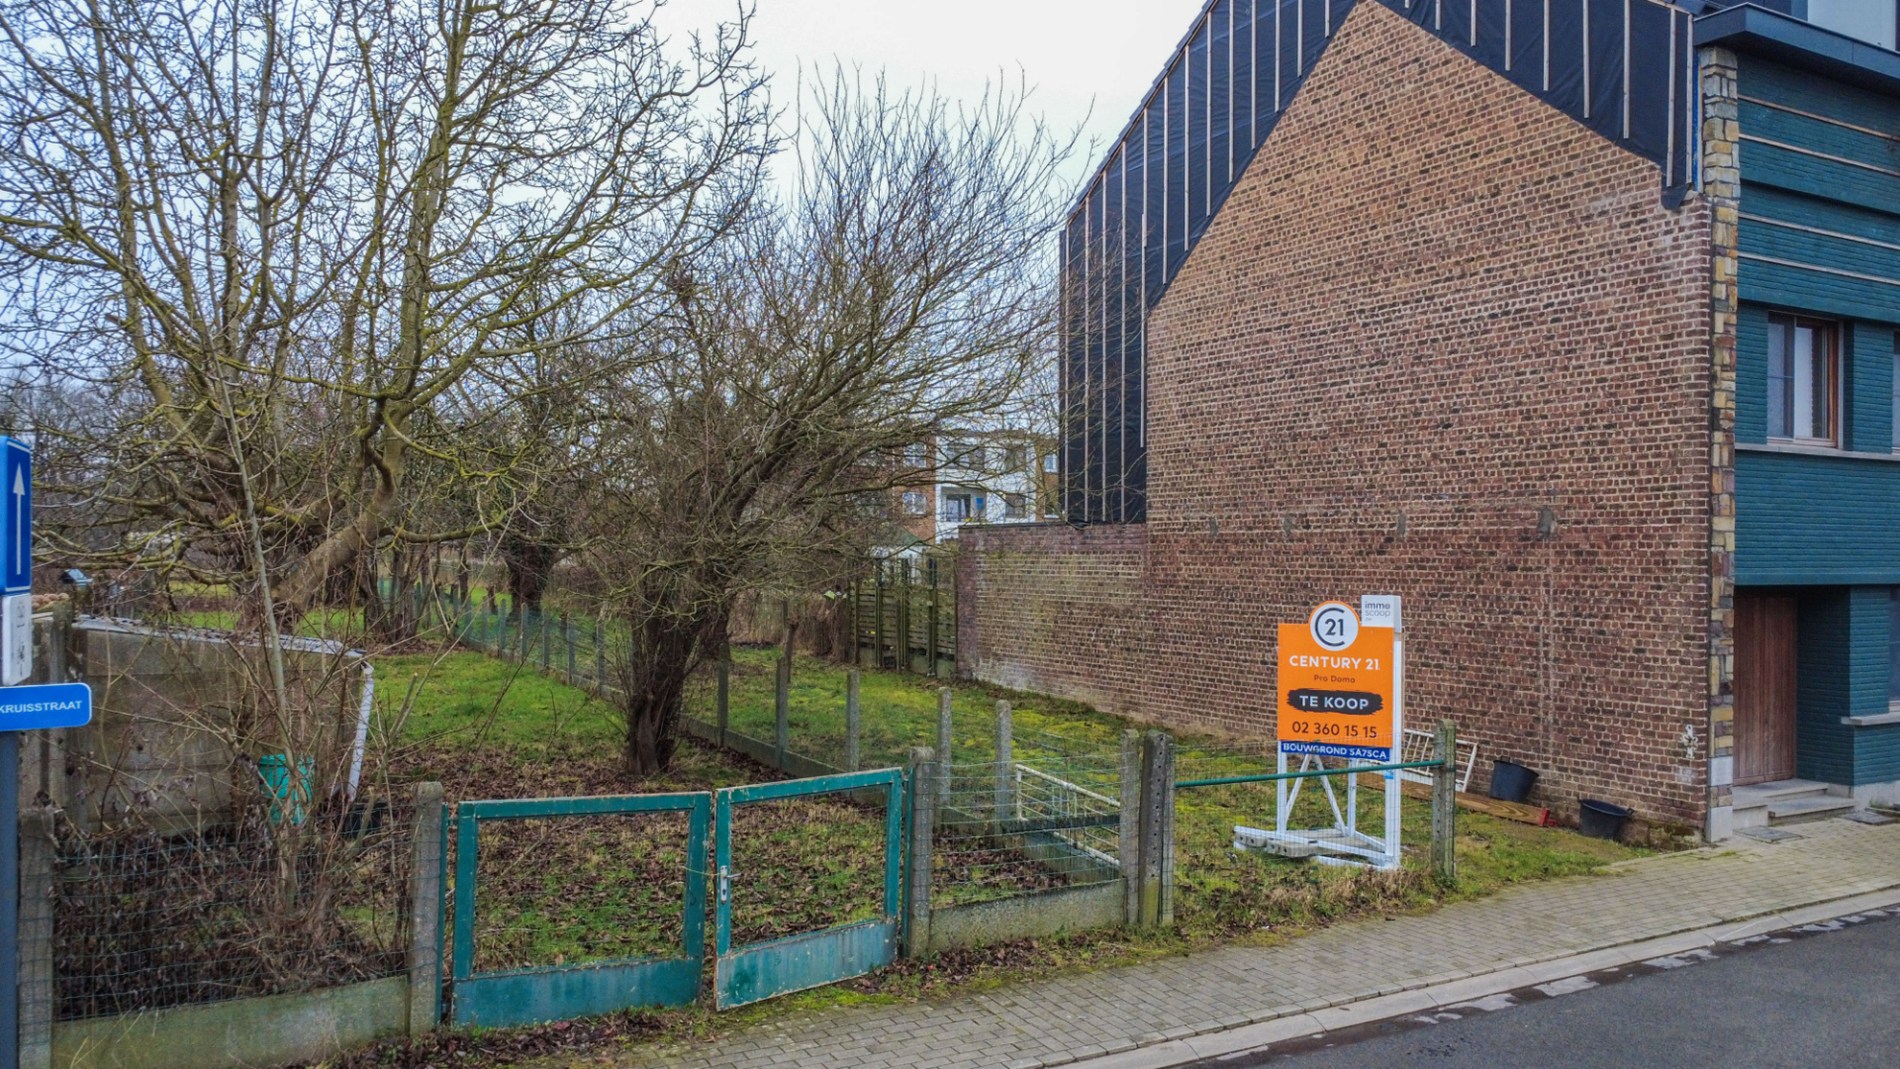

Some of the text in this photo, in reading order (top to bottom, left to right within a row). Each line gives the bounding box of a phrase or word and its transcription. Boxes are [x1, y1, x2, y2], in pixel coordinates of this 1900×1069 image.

[1365, 602, 1391, 610] immo
[1365, 610, 1391, 618] scoop
[1289, 655, 1380, 671] CENTURY 21
[1314, 674, 1356, 684] Pro Domo
[1300, 695, 1369, 710] TE KOOP
[1292, 721, 1377, 738] 02 360 15 15
[1283, 742, 1348, 755] BOUWGROND
